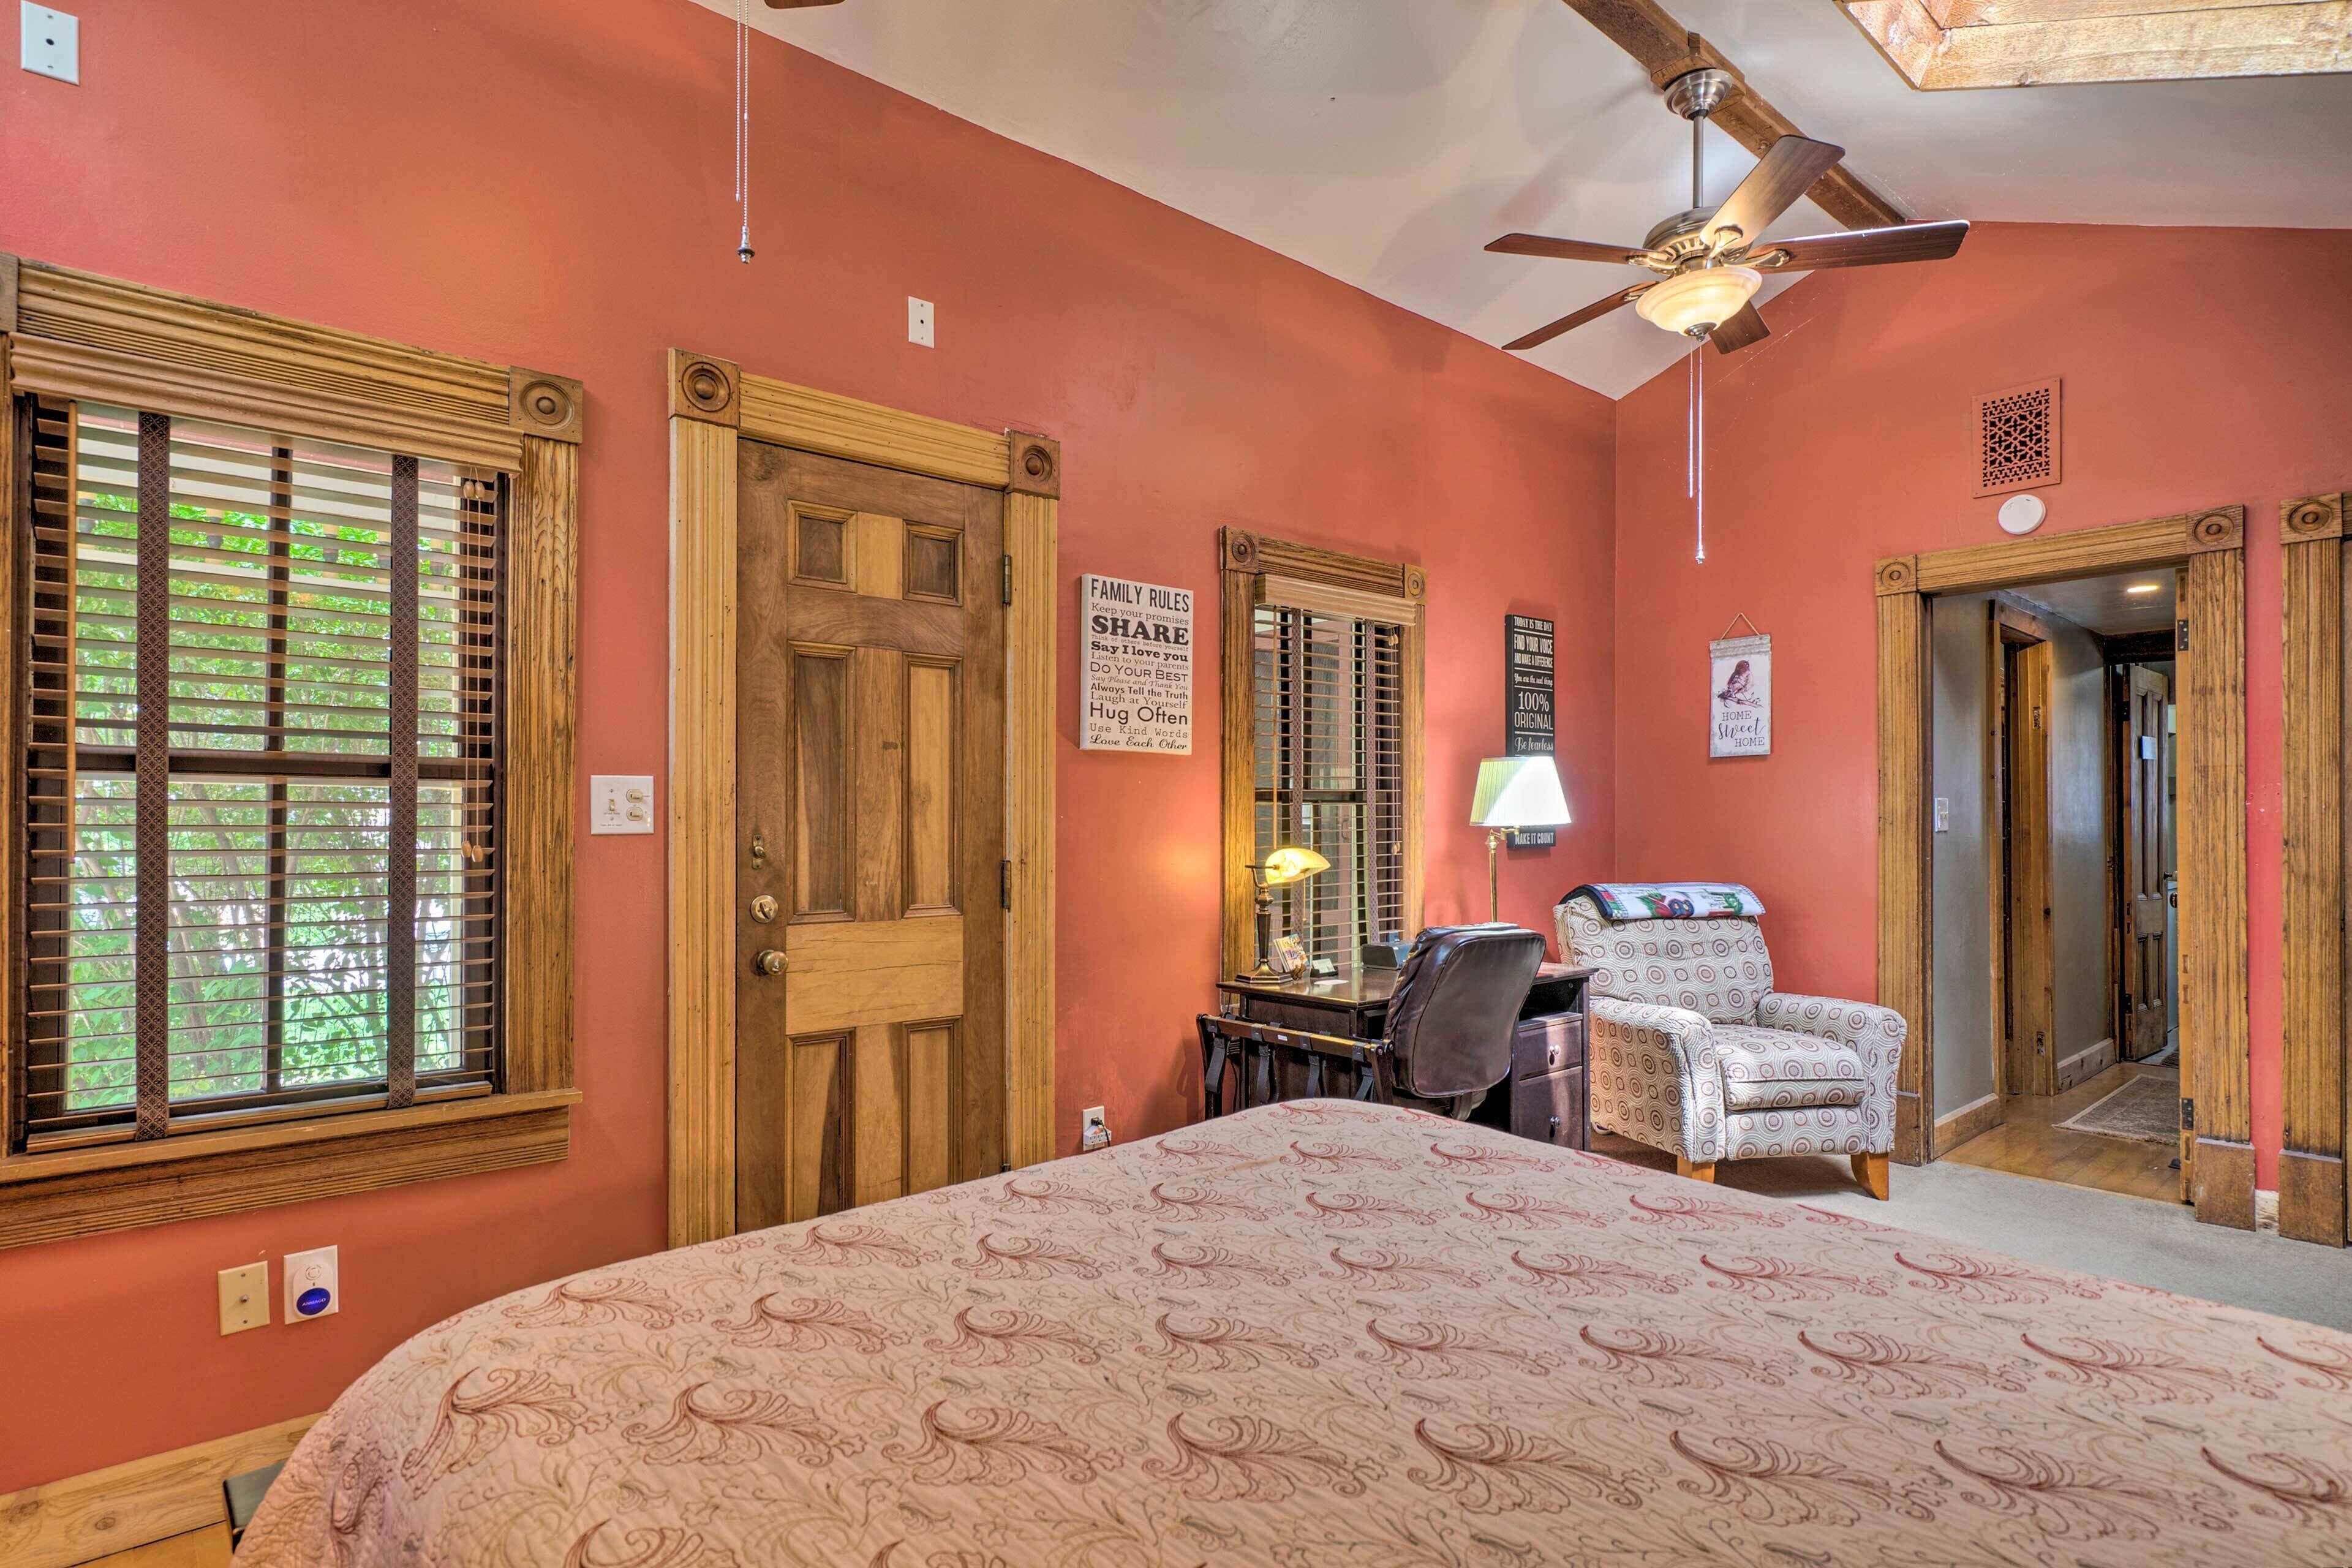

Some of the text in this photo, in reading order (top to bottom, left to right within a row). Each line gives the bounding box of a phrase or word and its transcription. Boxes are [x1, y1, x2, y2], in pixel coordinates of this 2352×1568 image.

[1091, 578, 1189, 612] FAMILY RULES
[1091, 603, 1189, 625] Keep your promises
[1091, 615, 1189, 646] SHARE
[1513, 616, 1553, 631] TODAY IS THE DAY
[1091, 641, 1188, 662] Say I love you
[1514, 634, 1553, 654] FIND YOUR VOICE
[1091, 651, 1120, 662] Listen
[1134, 658, 1155, 668] your
[1157, 661, 1189, 671] parents
[1521, 654, 1531, 665] MAKE
[1535, 655, 1553, 668] DIFFERENCE
[1091, 674, 1106, 682] Say
[1107, 676, 1131, 684] Please
[1148, 680, 1173, 689] Thank
[1115, 665, 1152, 678] YOUR
[1155, 669, 1188, 682] BEST
[1090, 682, 1188, 699] Always Tell the Truth
[1090, 691, 1125, 704] Laugh
[1144, 696, 1188, 709] Yourself
[1518, 691, 1550, 712] 100%
[1090, 702, 1188, 725] Hug Often
[1514, 712, 1553, 730] ORIGINAL
[1722, 710, 1752, 721] HOME
[1090, 723, 1188, 738] Use Kind Words
[1090, 734, 1187, 750] Love Each Other
[1515, 737, 1553, 752] Be fearless
[1735, 737, 1765, 747] HOME
[1515, 832, 1554, 845] MAKE IT COUNT
